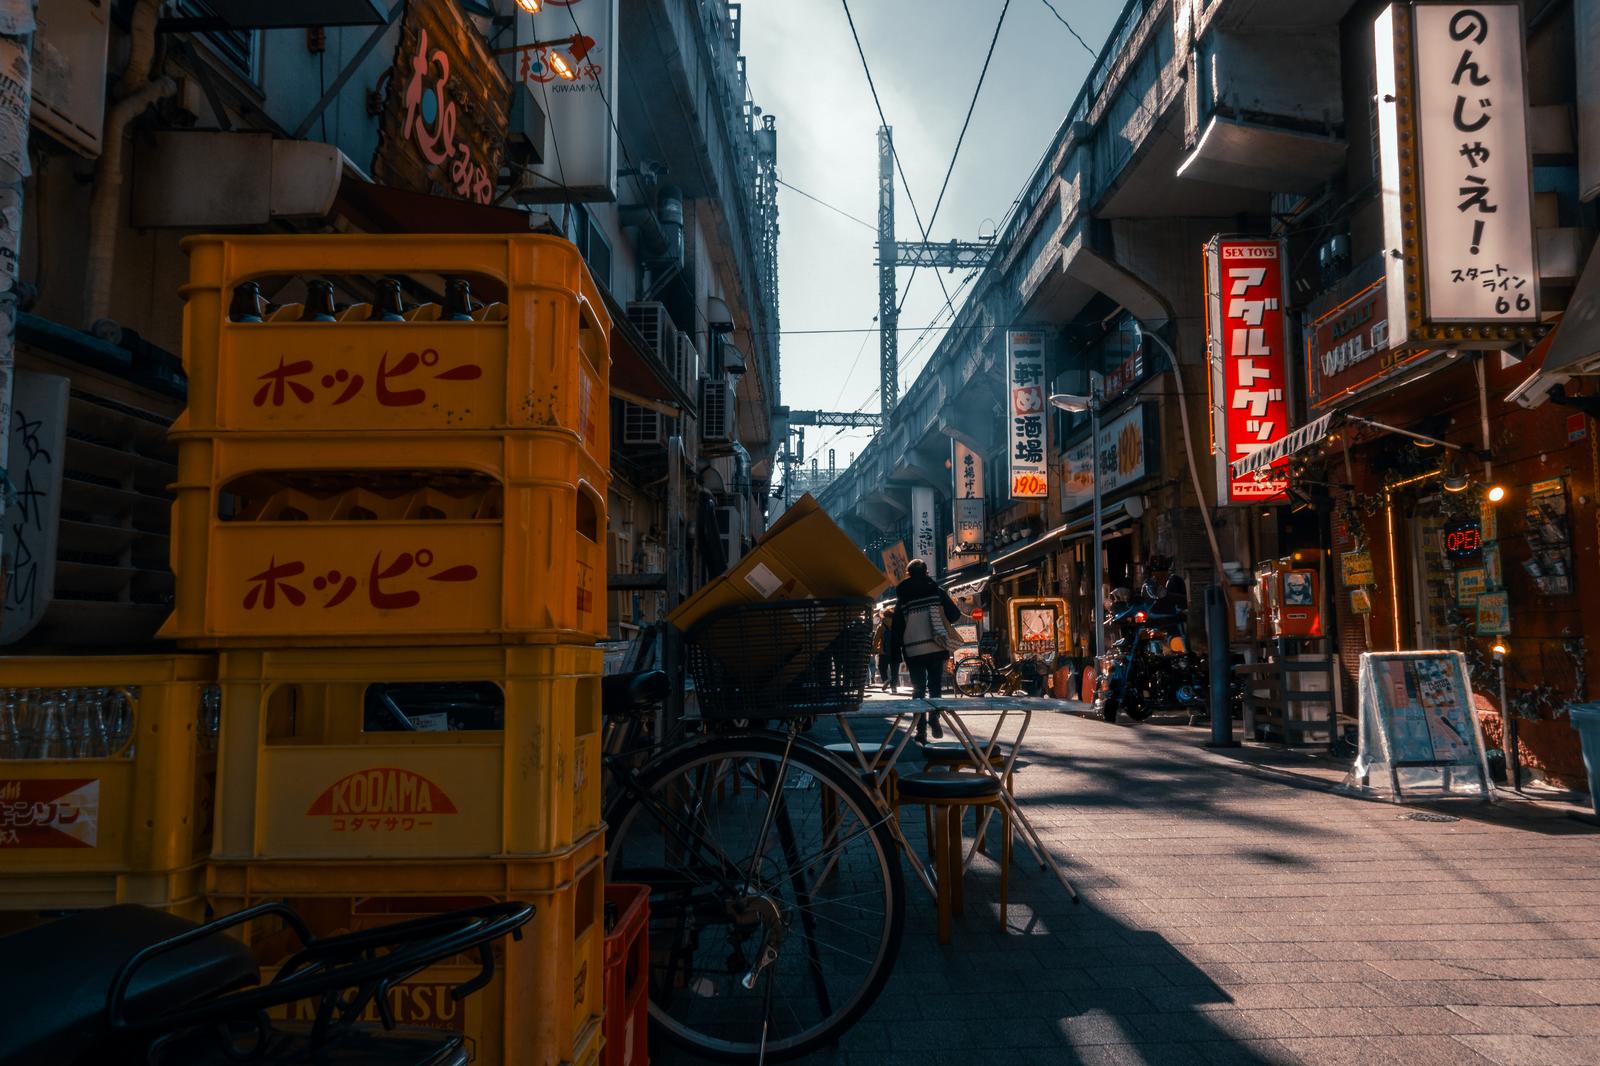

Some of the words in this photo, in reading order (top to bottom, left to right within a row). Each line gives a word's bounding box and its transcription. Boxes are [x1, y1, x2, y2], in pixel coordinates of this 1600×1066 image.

[1225, 248, 1245, 257] SEX
[1247, 247, 1275, 257] TOYS
[1451, 264, 1508, 282] スタート
[1482, 276, 1527, 292] ライン
[1495, 293, 1531, 314] 66
[254, 348, 483, 407] ホッピー
[1446, 528, 1483, 551] OPEN
[243, 548, 478, 609] ホッピー
[331, 770, 433, 814] KODAMA
[333, 818, 433, 832] コダマサワー
